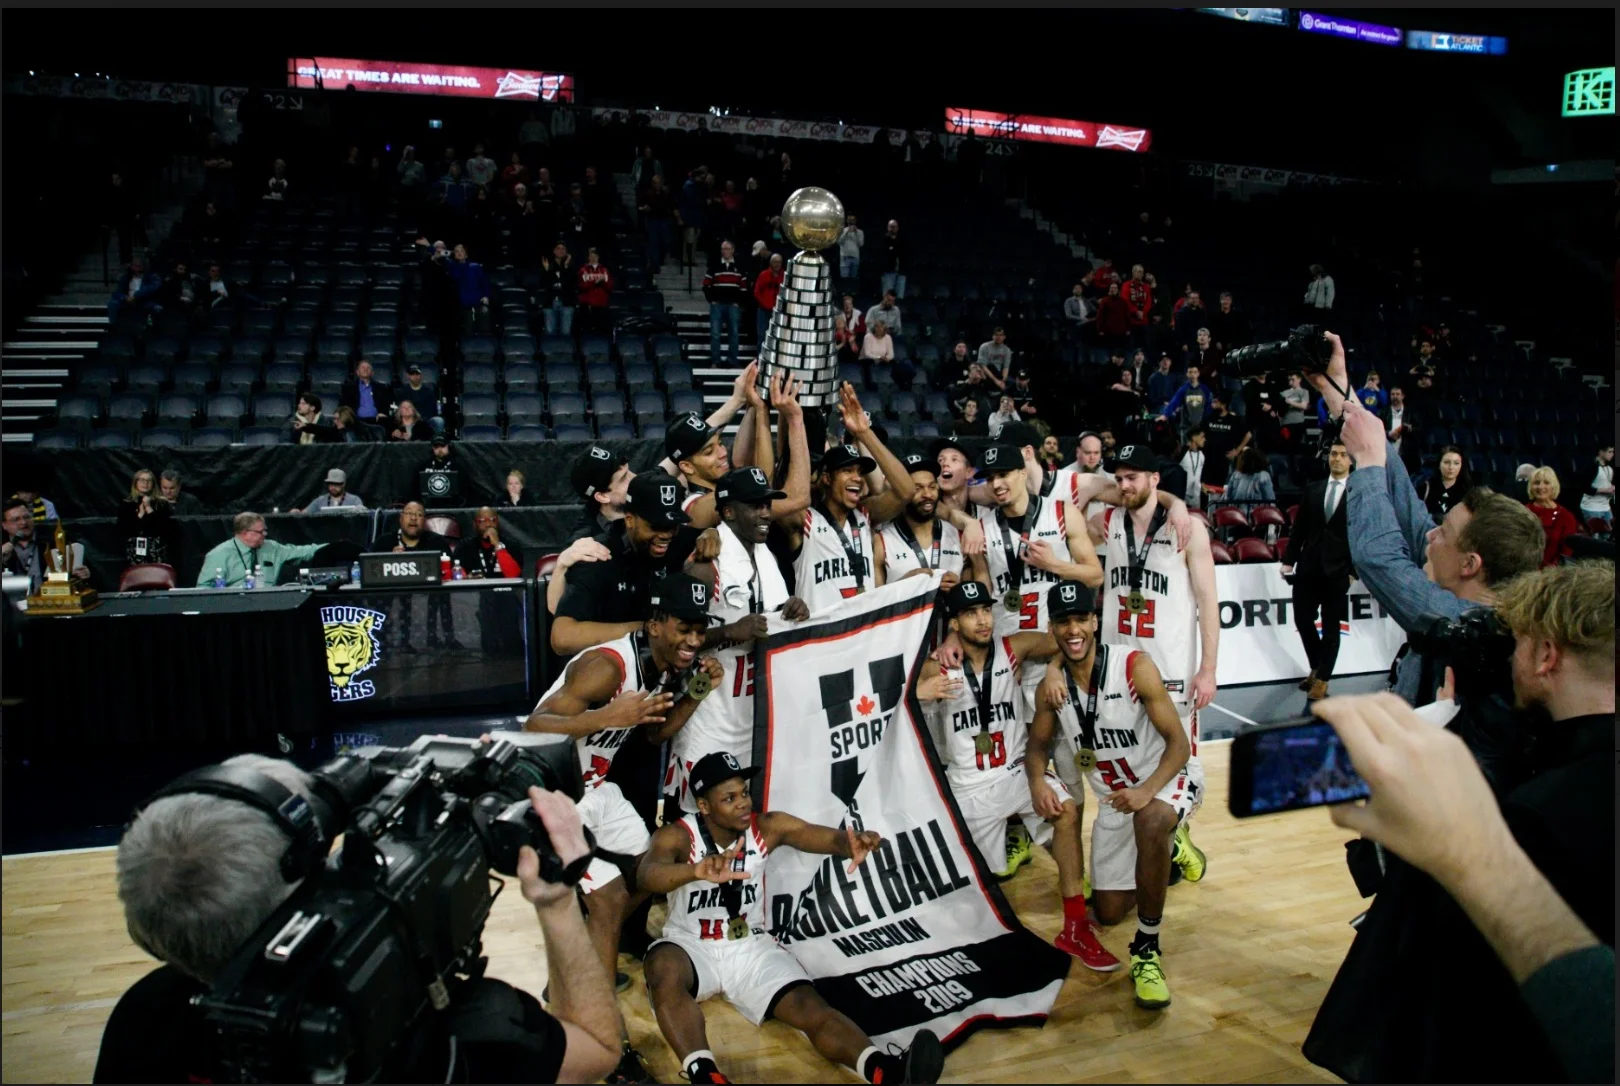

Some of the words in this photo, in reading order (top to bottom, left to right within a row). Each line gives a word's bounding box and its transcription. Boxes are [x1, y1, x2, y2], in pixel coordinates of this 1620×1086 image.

[1450, 43, 1484, 52] ATLANTIC
[1452, 35, 1484, 45] TICKET
[346, 69, 390, 83] TIMES
[391, 74, 419, 85] ARE
[420, 75, 480, 88] WAITING.
[1021, 123, 1042, 134] ARE
[1043, 126, 1086, 139] WAITING.
[383, 562, 419, 577] POSS.
[1118, 595, 1155, 638] 22
[971, 731, 1007, 771] 10
[1096, 757, 1140, 792] 21
[831, 916, 931, 958] MASCULIN
[855, 951, 982, 998] CHAMPIONS
[913, 980, 974, 1014] 2019
